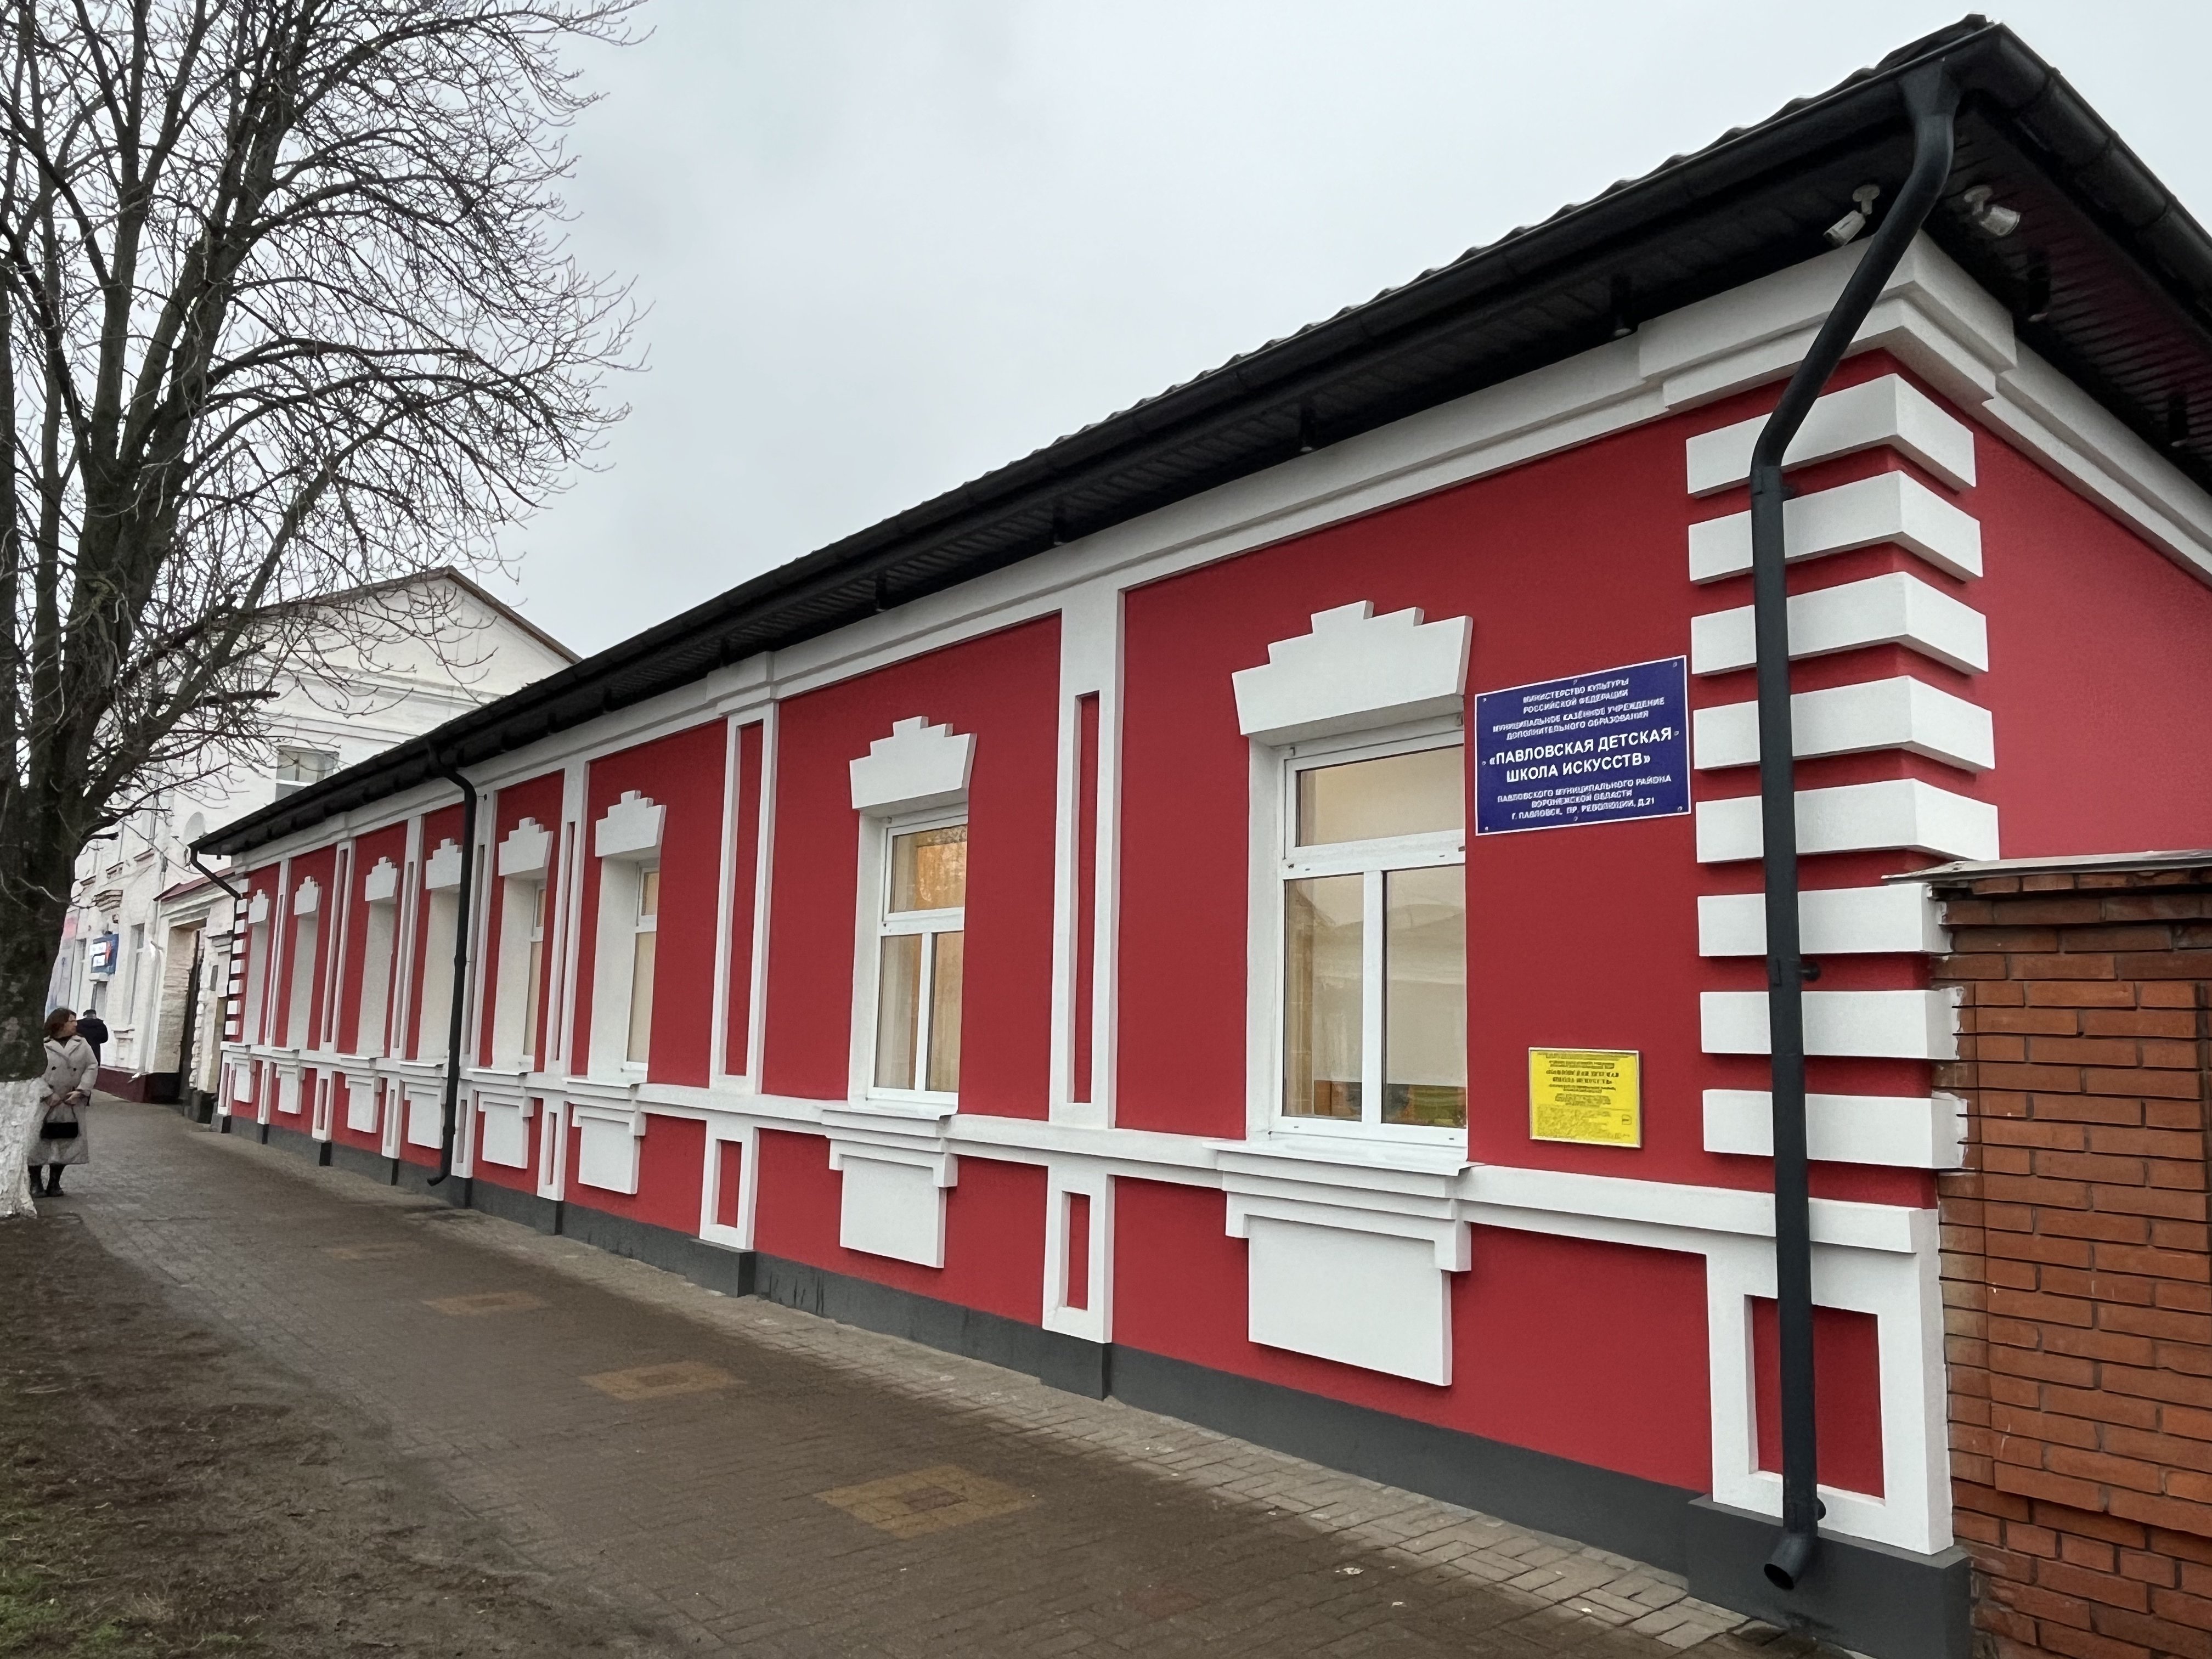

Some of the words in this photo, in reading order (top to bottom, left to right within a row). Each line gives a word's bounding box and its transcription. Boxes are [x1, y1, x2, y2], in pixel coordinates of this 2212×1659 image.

[1523, 697, 1577, 714] РОССИЙСКОЙ
[1506, 721, 1585, 741] ДОПОЛНИТЕЛЬНОГО
[1489, 738, 1594, 765] «ПАВЛОВСКАЯ
[1598, 727, 1672, 753] ДЕТСКАЯ
[1506, 764, 1558, 783] ШКОЛА
[1562, 752, 1651, 775] ИСКУССТВ»
[1497, 790, 1553, 803] ПАВЛОВСКОГО
[1636, 774, 1672, 786] РАЙОНА
[1594, 789, 1632, 800] ОБЛАСТИ
